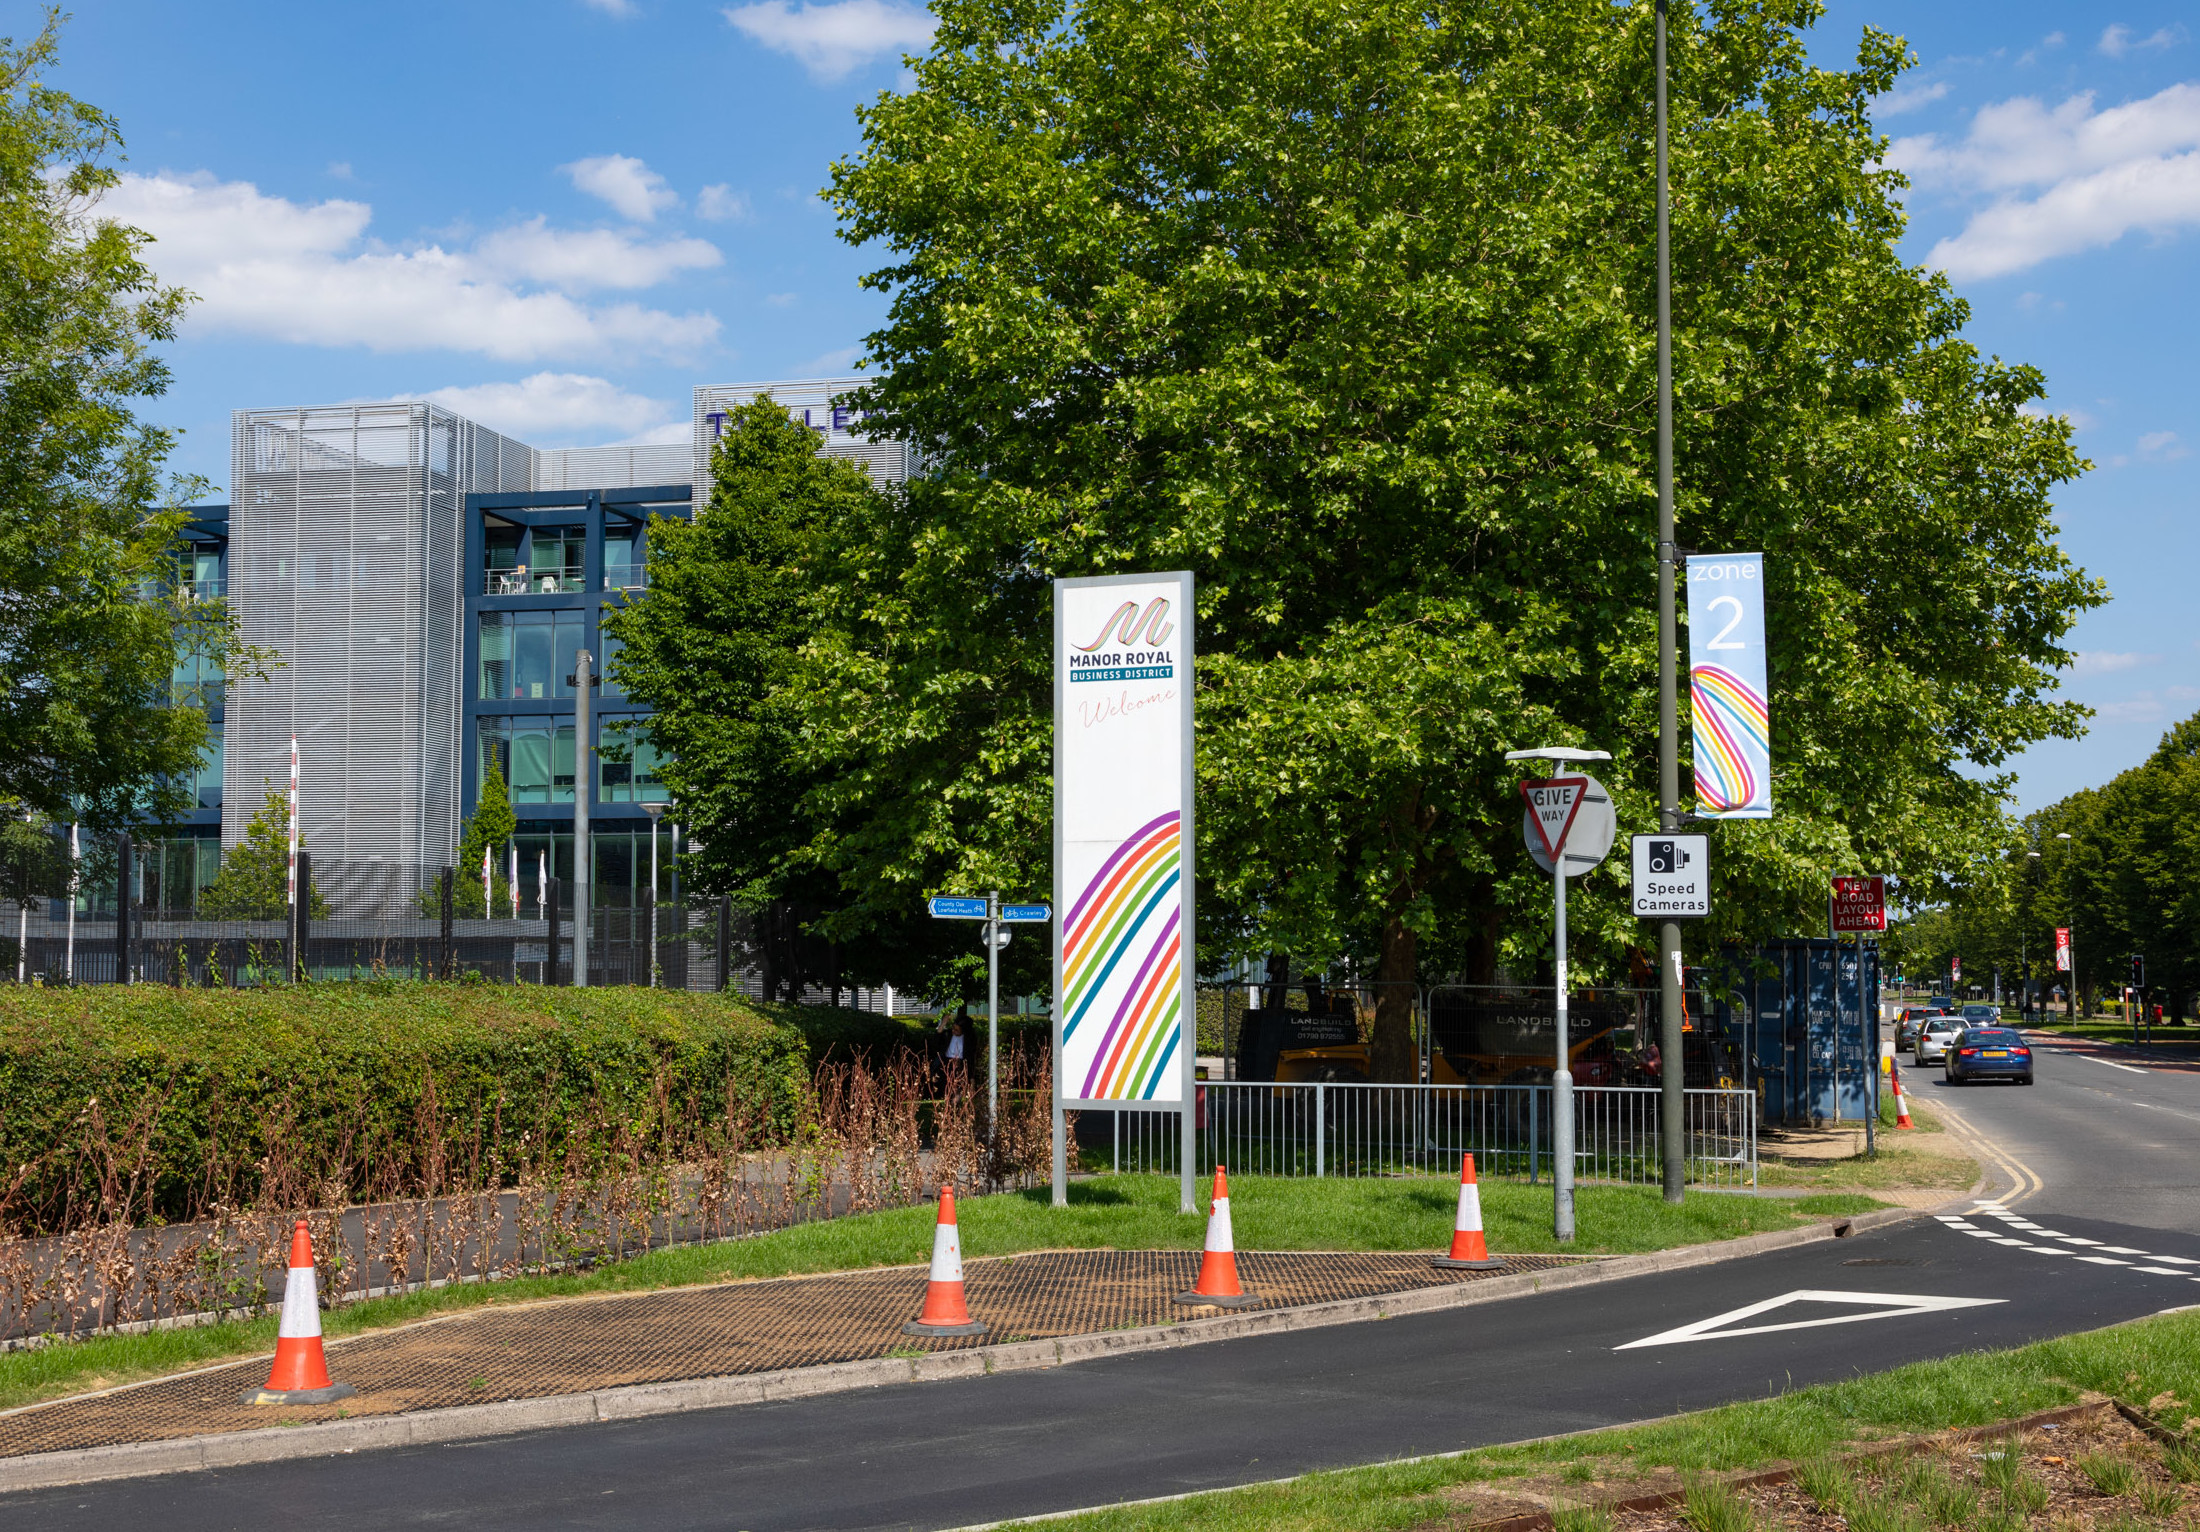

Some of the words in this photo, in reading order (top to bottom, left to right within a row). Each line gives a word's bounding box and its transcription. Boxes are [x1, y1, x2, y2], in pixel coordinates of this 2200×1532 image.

[1693, 563, 1756, 581] zone
[1706, 595, 1746, 650] 2
[1070, 654, 1121, 667] MANOR
[1126, 651, 1173, 665] ROYAL
[1072, 669, 1121, 681] BUSINESS
[1125, 668, 1171, 679] DISTRICT
[1079, 690, 1177, 728] Welcome
[1534, 789, 1572, 806] GIVE
[1541, 810, 1565, 822] WAY
[1647, 882, 1695, 896] Speed
[1843, 881, 1871, 891] NEW
[1841, 893, 1874, 903] ROAD
[1637, 898, 1705, 911] Cameras
[1836, 904, 1881, 915] LAYOUT
[1838, 916, 1880, 926] AHEAD
[2058, 935, 2066, 944] 3
[1291, 1018, 1351, 1026] LANDBUILD
[1496, 1015, 1592, 1027] LANDBLD
